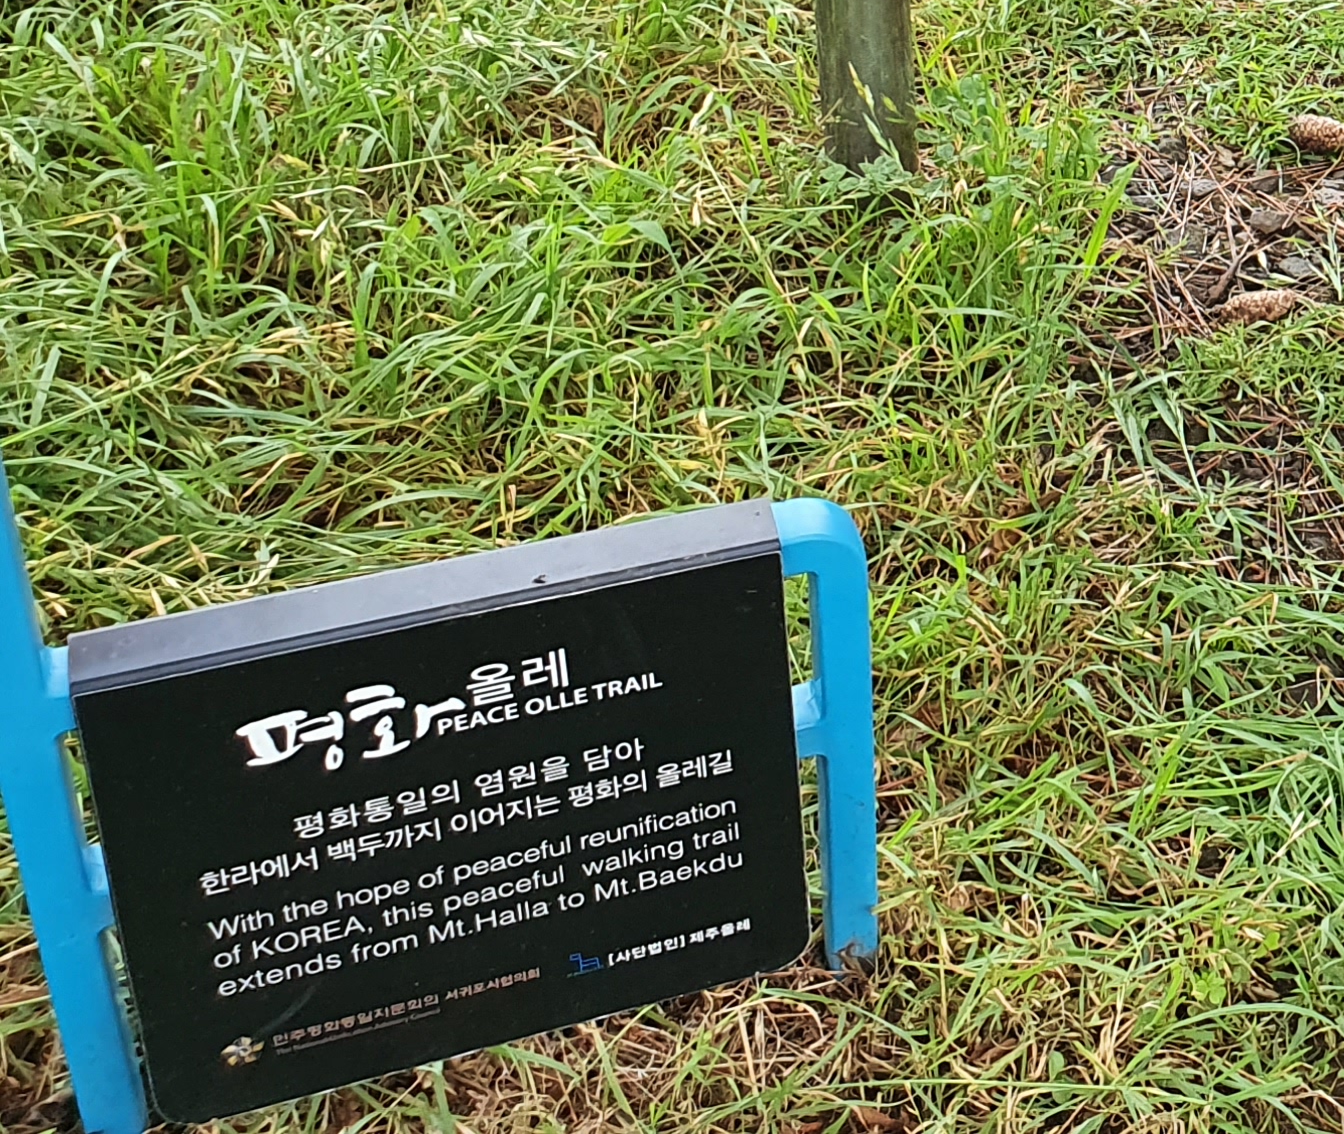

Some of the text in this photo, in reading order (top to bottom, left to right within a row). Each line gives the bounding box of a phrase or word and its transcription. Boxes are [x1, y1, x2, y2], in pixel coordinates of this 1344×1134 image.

[437, 672, 663, 736] PEACE OLLE TRAIL
[199, 749, 733, 896] 한라에서 백두까지 이어지는 평화의 올레길
[293, 737, 645, 839] 평화통일의 염원을 담아
[207, 800, 736, 940] With the hope of peaceful reunification
[213, 821, 740, 969] of KOREA, this peaceful walking trail
[218, 852, 743, 997] extends from Mt.Halla to Mt.Baekdu
[608, 917, 751, 967] [사단법인] 제주올레
